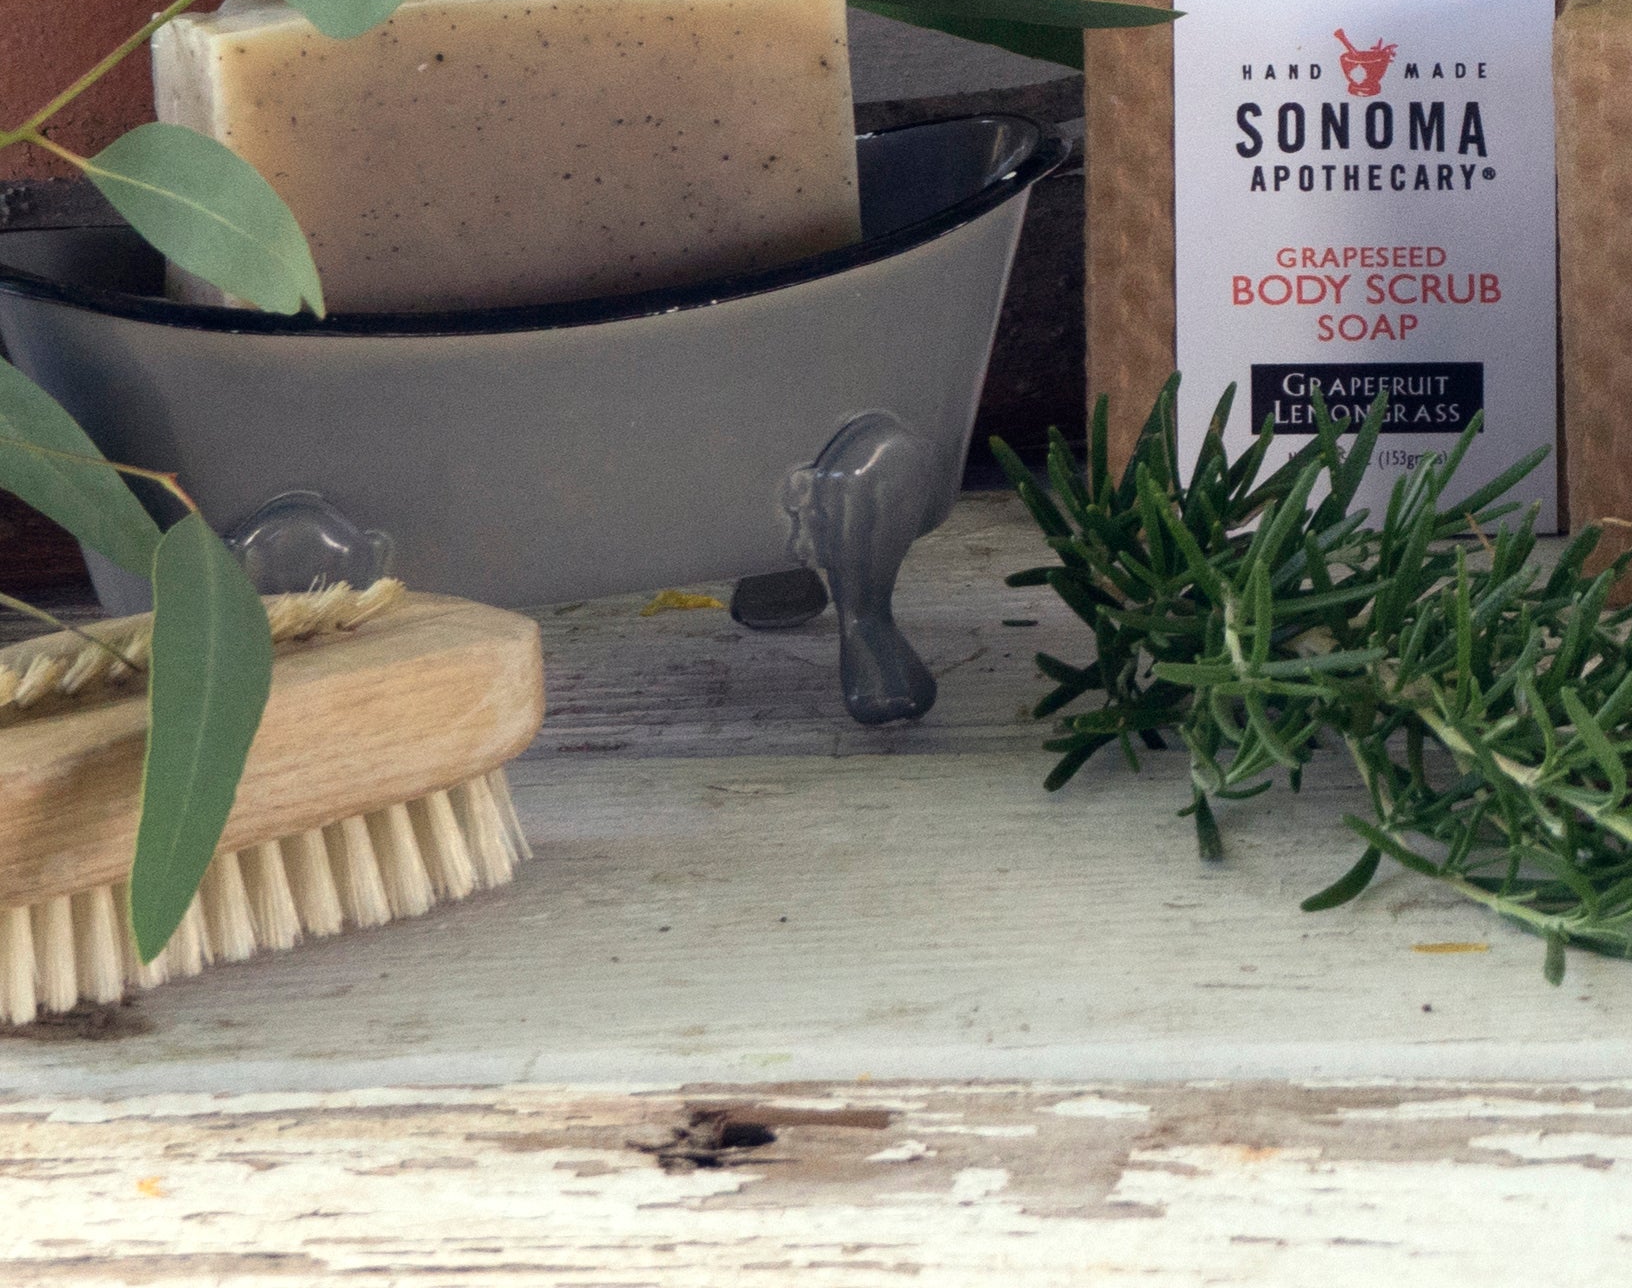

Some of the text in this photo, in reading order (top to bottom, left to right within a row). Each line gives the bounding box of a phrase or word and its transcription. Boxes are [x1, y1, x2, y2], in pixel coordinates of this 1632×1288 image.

[1243, 63, 1486, 79] HAND MADE
[1237, 102, 1487, 158] SONOMA
[1277, 247, 1446, 268] GRAPESEED
[1233, 274, 1501, 305] BODY SCRUB
[1318, 314, 1418, 342] SOAP
